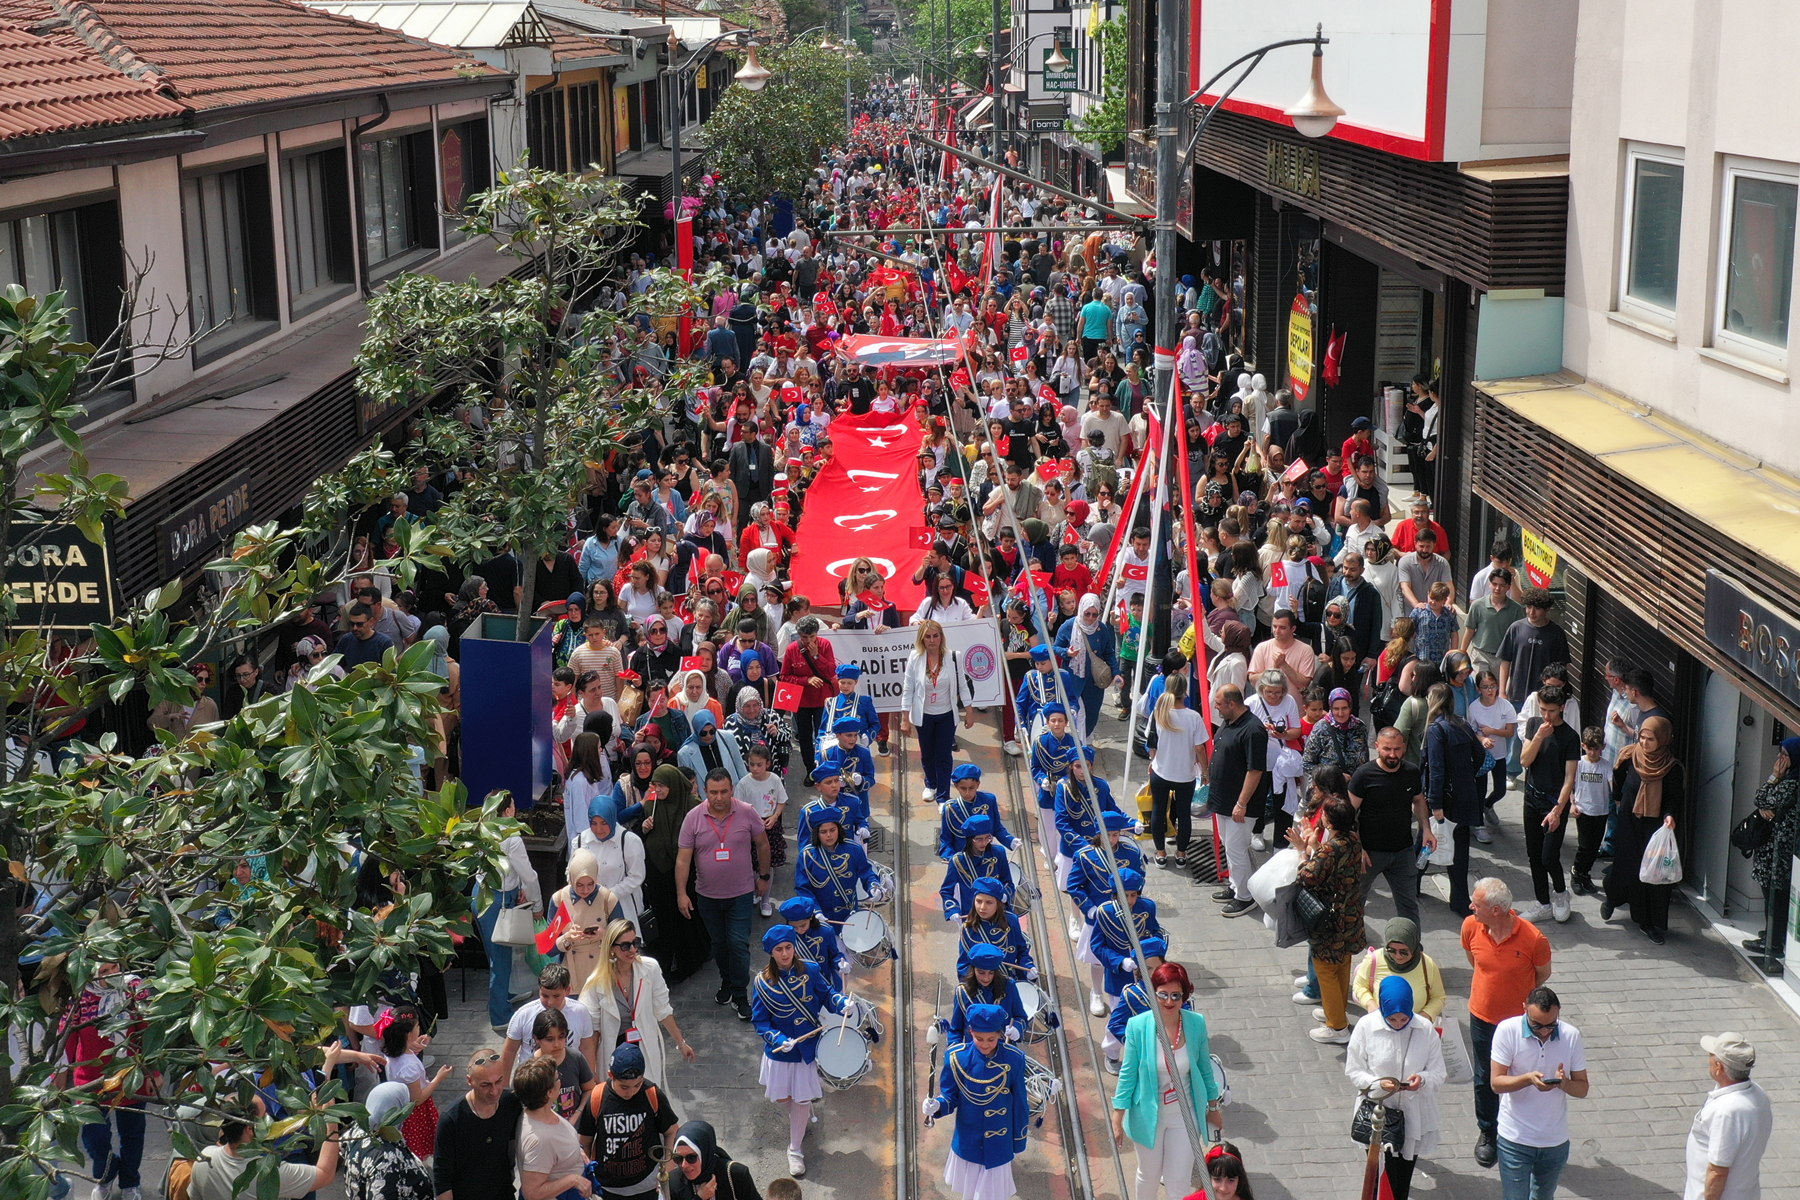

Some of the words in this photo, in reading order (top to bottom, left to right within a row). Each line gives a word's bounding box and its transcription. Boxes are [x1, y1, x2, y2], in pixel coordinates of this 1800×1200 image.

[1046, 81, 1076, 89] HAC-UMRE
[170, 513, 207, 560] DORA
[209, 484, 249, 533] PERDE
[1581, 773, 1602, 782] YOUNG
[603, 1112, 646, 1135] VISION
[606, 1137, 620, 1154] OF
